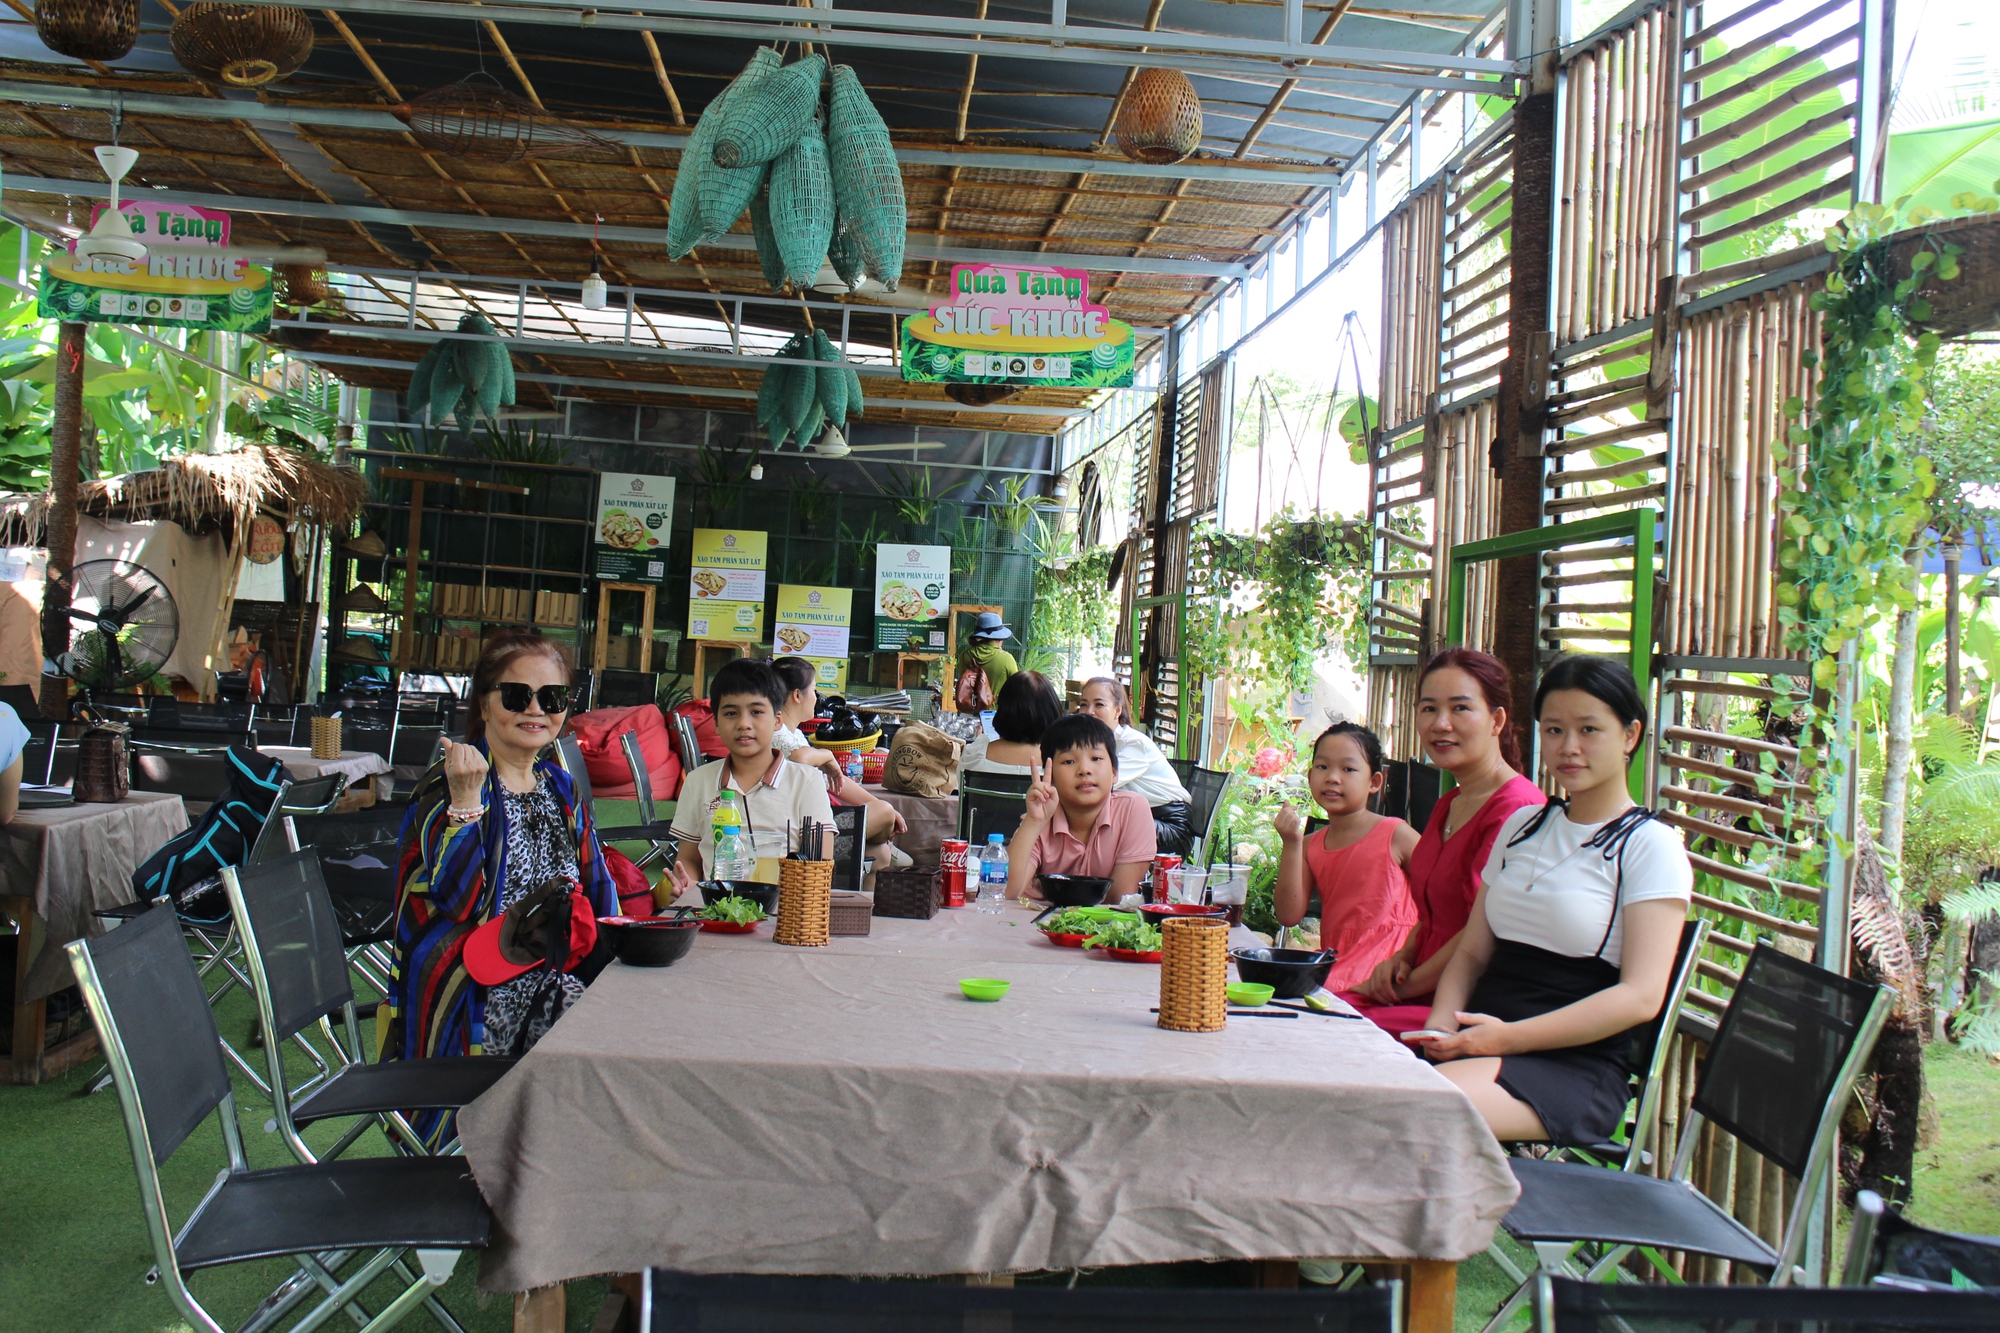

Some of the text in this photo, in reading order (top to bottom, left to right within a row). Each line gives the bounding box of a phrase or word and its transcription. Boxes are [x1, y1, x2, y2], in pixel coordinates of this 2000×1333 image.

[157, 210, 223, 242] Tặng
[957, 268, 1082, 300] Quà Tặng
[934, 298, 999, 336] SỨC
